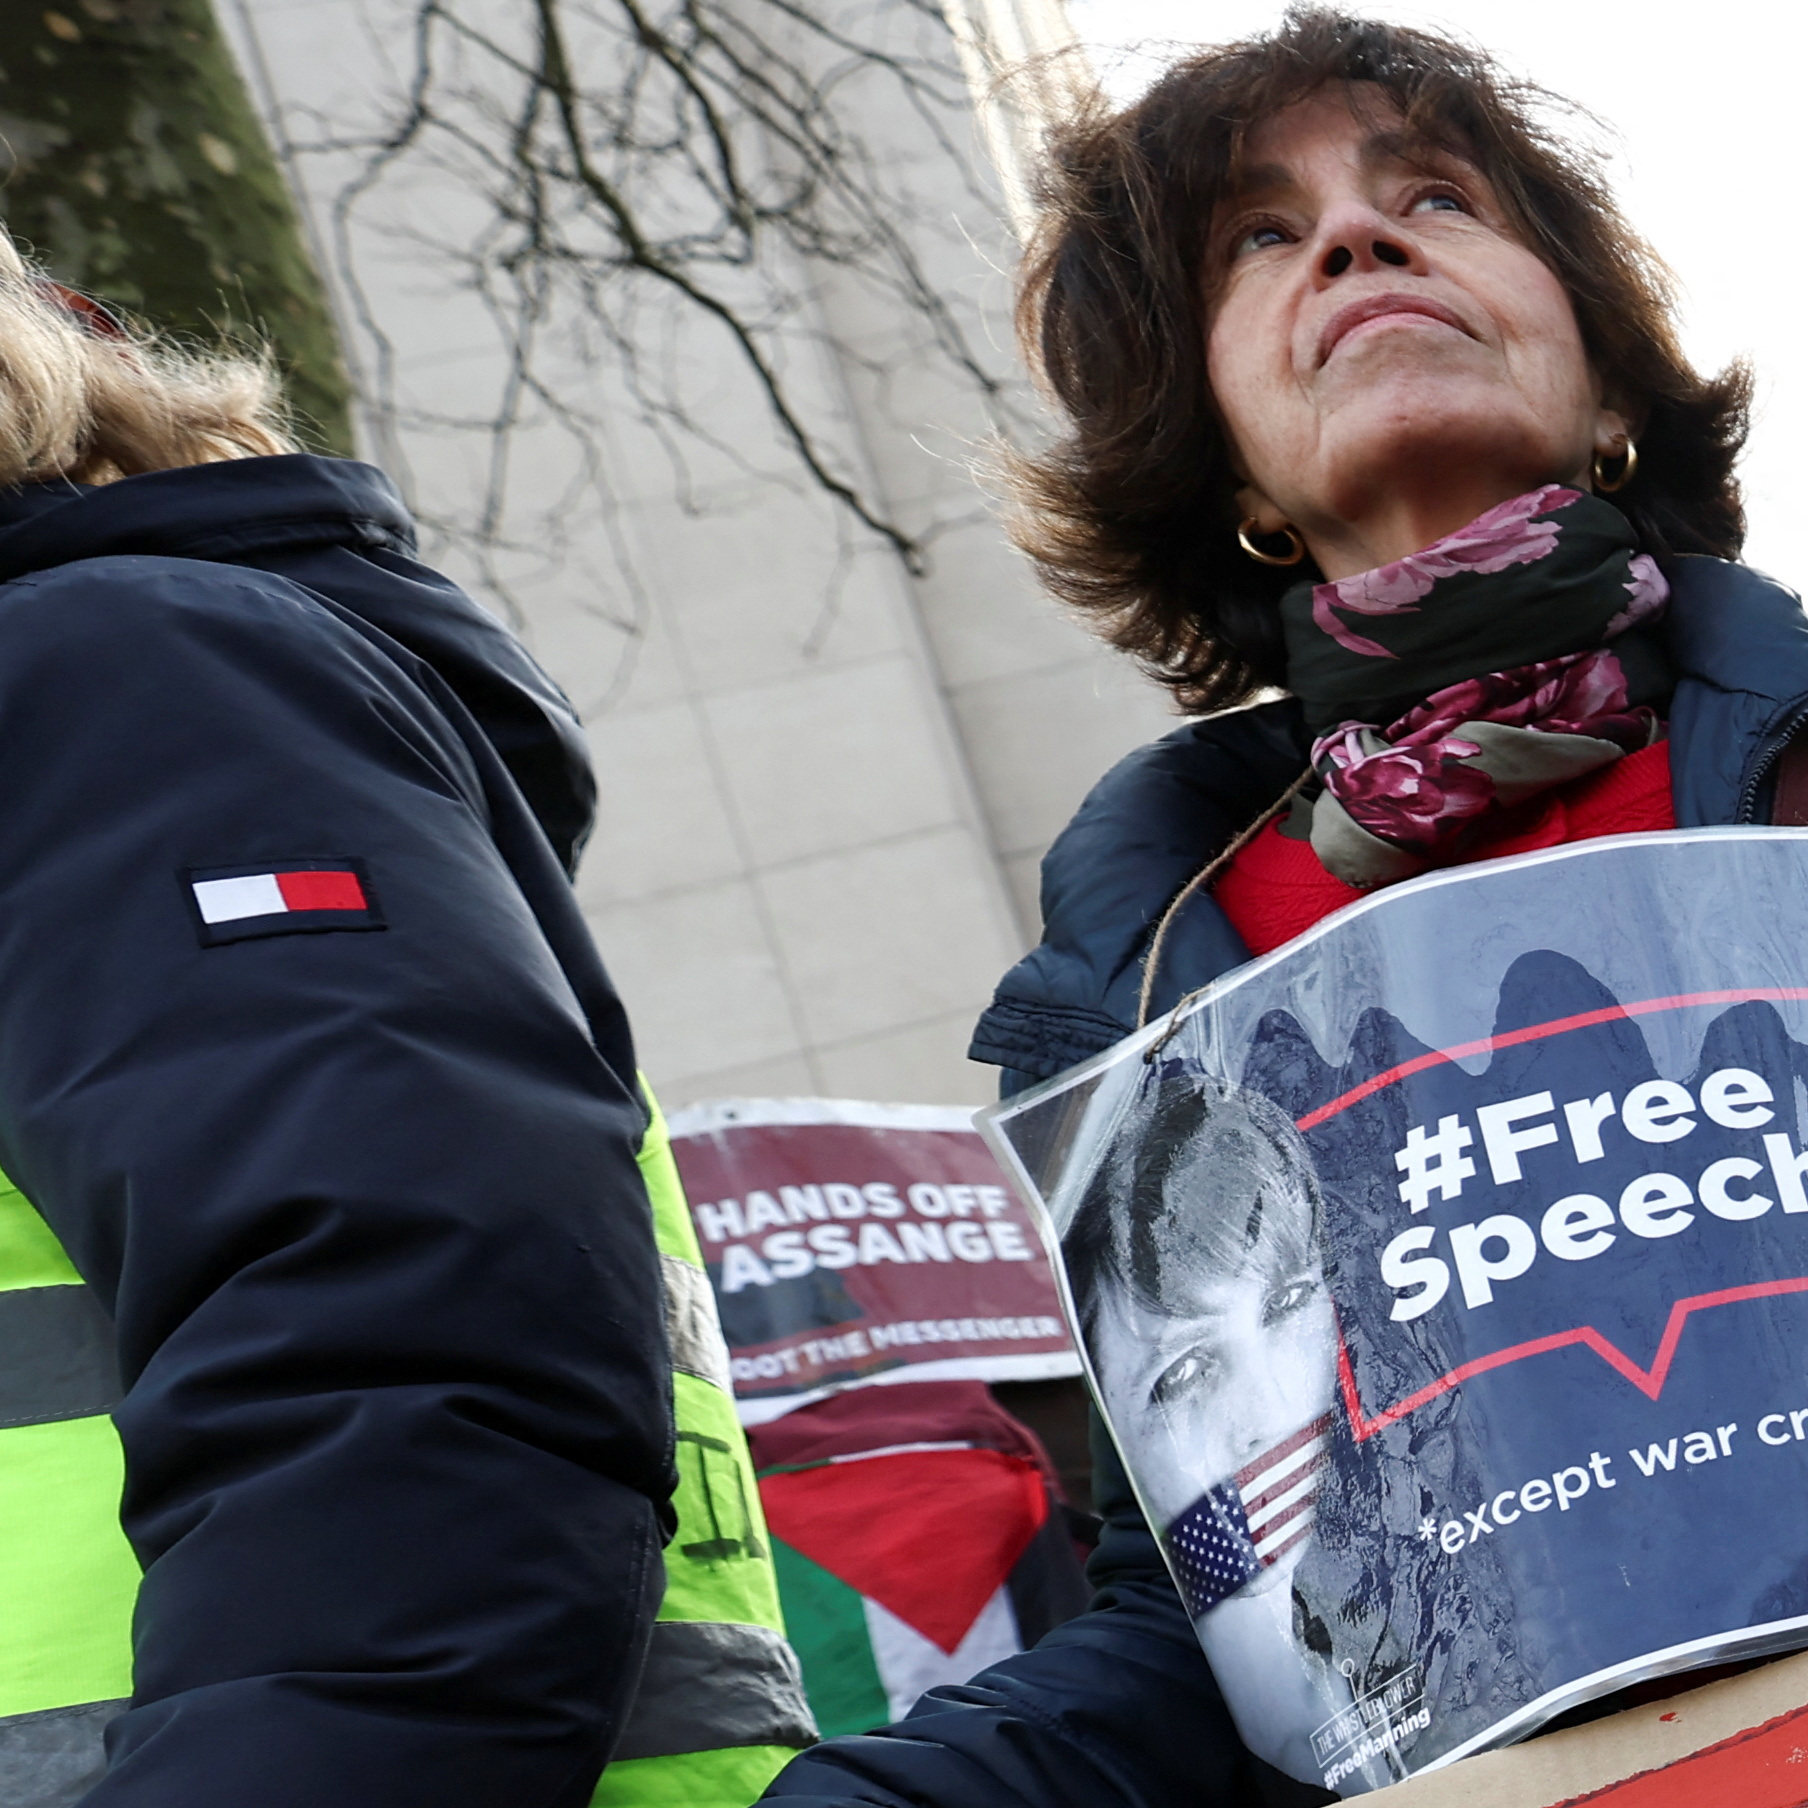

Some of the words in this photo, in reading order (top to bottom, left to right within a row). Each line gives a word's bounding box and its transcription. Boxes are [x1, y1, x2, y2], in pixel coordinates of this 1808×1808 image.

[1394, 1067, 1775, 1215] #Free
[698, 1182, 906, 1242] HANDS
[908, 1182, 1010, 1218] OFF
[720, 1221, 1035, 1293] ASSANGE
[801, 1331, 871, 1367] THE
[868, 1315, 1063, 1350] MESSENGER
[1628, 1422, 1738, 1478] war
[1323, 1706, 1431, 1791] #FreeManning
